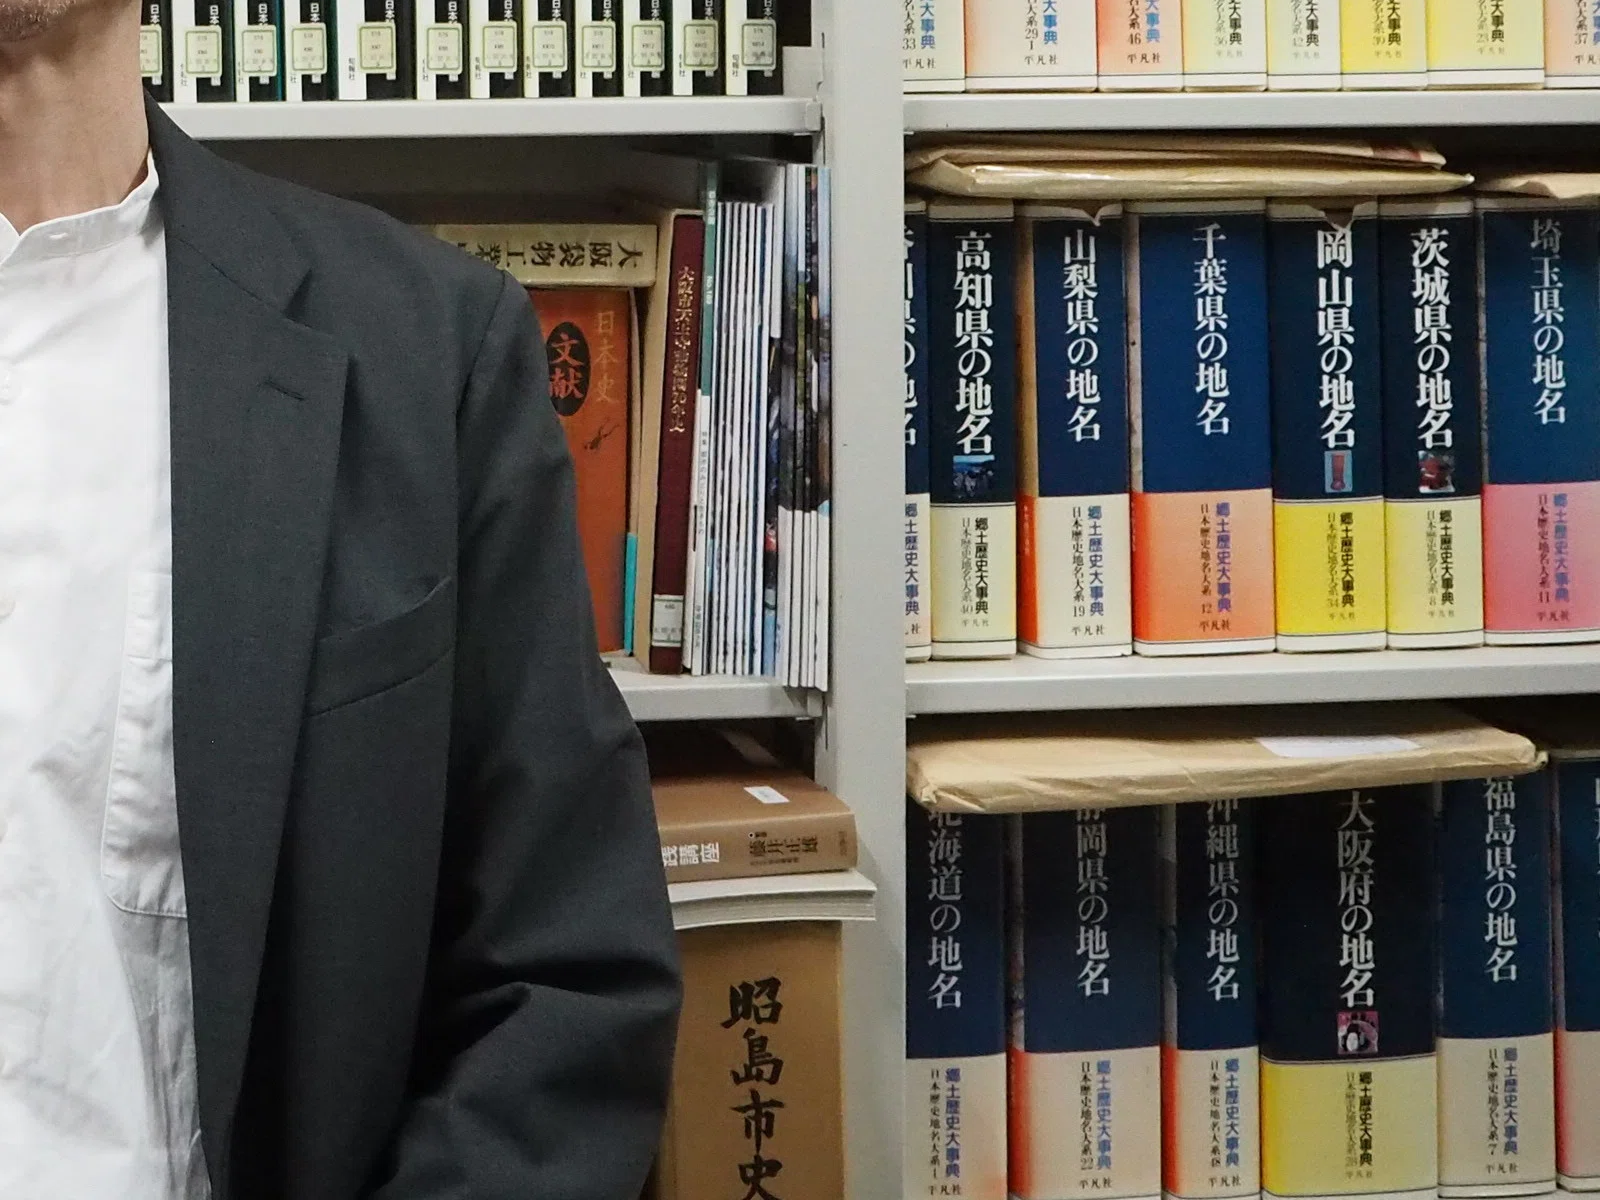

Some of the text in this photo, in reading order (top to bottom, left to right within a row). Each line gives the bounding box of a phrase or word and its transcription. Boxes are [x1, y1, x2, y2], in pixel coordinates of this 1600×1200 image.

[902, 57, 937, 69] 平凡社
[1024, 54, 1059, 65] 平凡社
[1127, 52, 1161, 64] 平凡社
[549, 333, 585, 400] 文献
[594, 310, 619, 403] 日本史
[954, 230, 994, 454] 高知県の地名
[1062, 226, 1102, 442] 山梨県の地名
[1192, 221, 1232, 436] 千葉県の地名
[1316, 228, 1356, 450] 岡山県の地名
[1410, 226, 1454, 450] 茨城県の地名
[1530, 218, 1567, 426] 埼玉県の地名
[904, 502, 920, 617] 郷土歴史大事典
[975, 517, 989, 615] 郷土歴史大事典
[1088, 505, 1104, 617] 郷土歴史大事典
[1216, 502, 1232, 614] 郷土歴史大事典
[1340, 512, 1355, 608] 郷土歴史大事典
[1439, 510, 1455, 606] 郷土歴史大事典
[1553, 492, 1570, 603] 郷土歴史大事典
[1071, 624, 1105, 636] 平凡社
[1200, 619, 1232, 632] 平凡社
[1337, 790, 1376, 1008] 大阪府の地名
[1484, 776, 1518, 984] 福島県の地名
[720, 976, 786, 1200] 昭島市史
[945, 1067, 961, 1178] 郷土歴史大事典
[1096, 1060, 1112, 1170] 郷土歴史大事典
[1225, 1058, 1241, 1168] 郷土歴史大事典
[1358, 1070, 1373, 1167] 郷土歴史大事典
[1503, 1047, 1518, 1155] 郷土歴史大事典
[1079, 1176, 1113, 1189] 平凡社
[1208, 1175, 1242, 1188] 平凡社
